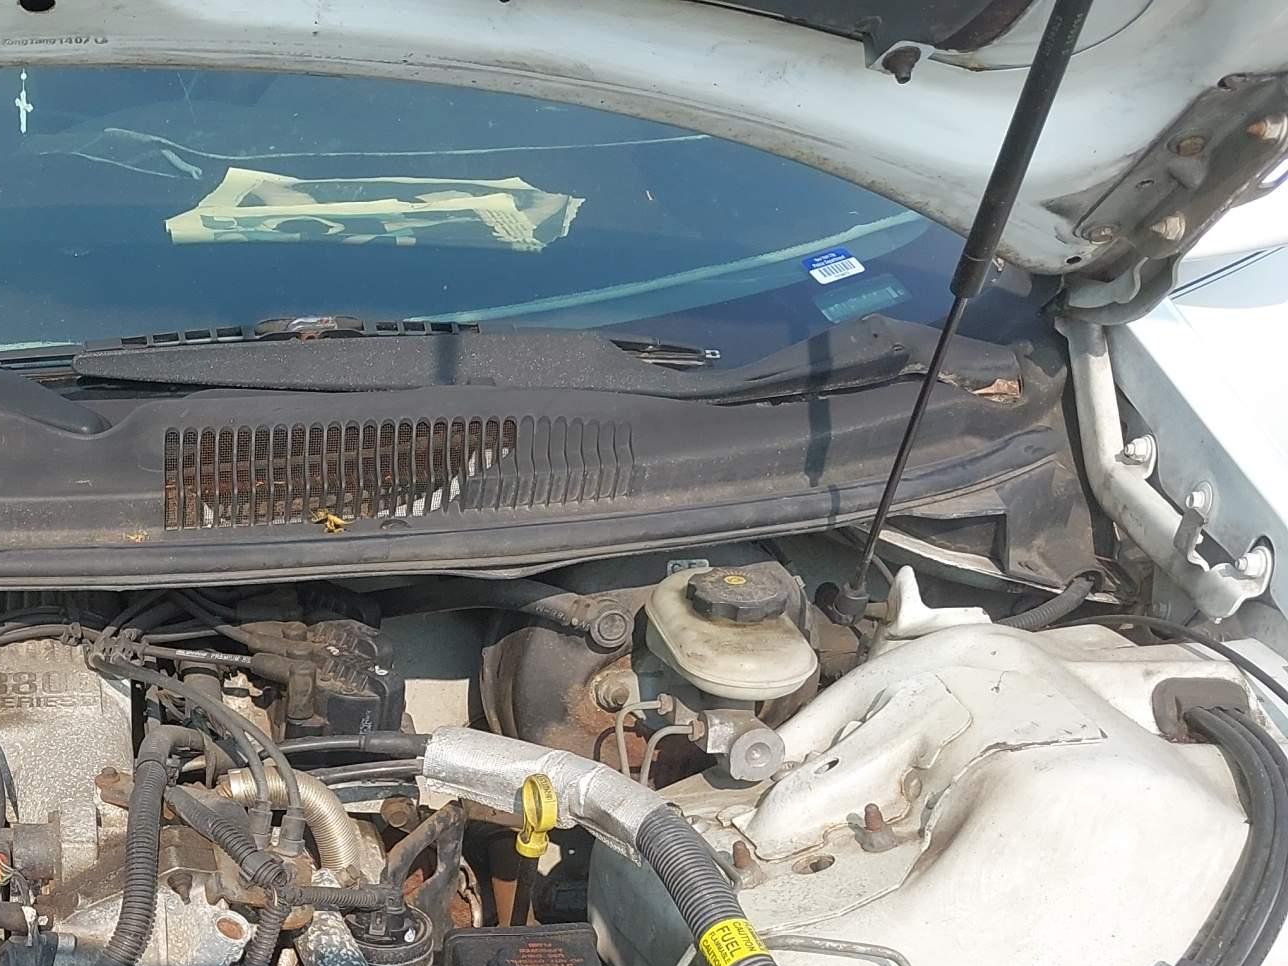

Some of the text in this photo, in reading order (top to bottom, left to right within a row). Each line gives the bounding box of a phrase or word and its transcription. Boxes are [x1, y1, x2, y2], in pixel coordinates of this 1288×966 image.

[708, 932, 731, 964] FLAMMABLE
[716, 925, 742, 958] FUEL
[732, 922, 756, 951] CAUTION
